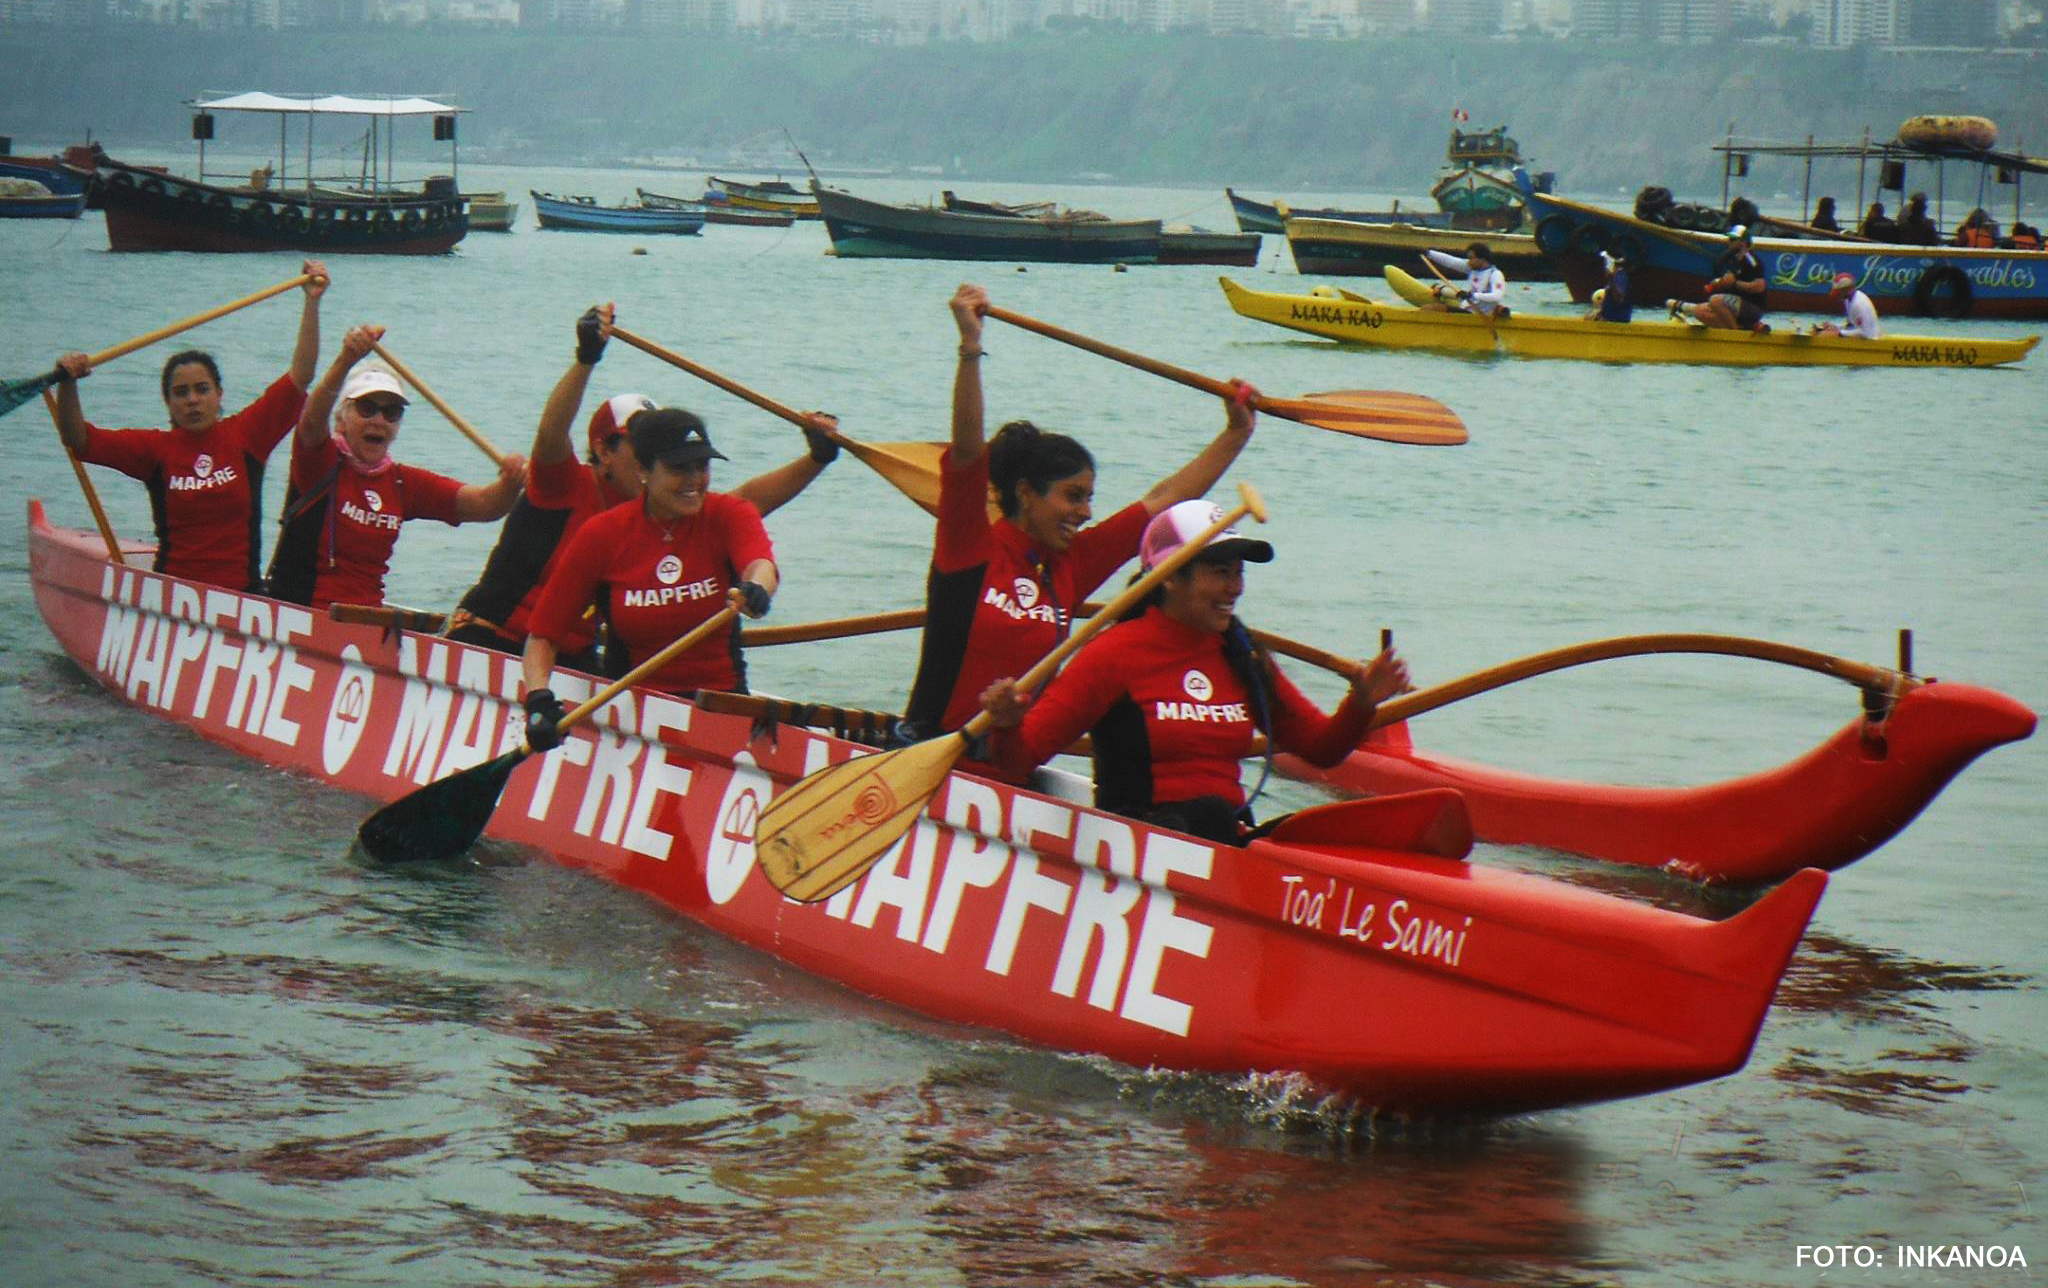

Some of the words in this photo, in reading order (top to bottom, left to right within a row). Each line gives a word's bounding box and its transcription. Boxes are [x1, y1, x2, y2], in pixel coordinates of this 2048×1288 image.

[1771, 252, 1836, 288] Las
[1291, 303, 1343, 325] MAKA
[1348, 309, 1383, 328] KAO
[1891, 345, 1941, 363] MAKA
[1944, 346, 1978, 365] KAO
[169, 466, 238, 490] MAPFRE
[341, 500, 401, 530] MAPFR
[624, 577, 720, 607] MAPFRE
[984, 587, 1068, 626] MAPFRE
[97, 565, 316, 747] MAPFRE
[1156, 701, 1249, 722] MAPFRE
[1281, 875, 1336, 930] Toa'
[1339, 887, 1375, 942] Le
[1382, 899, 1473, 966] Sami
